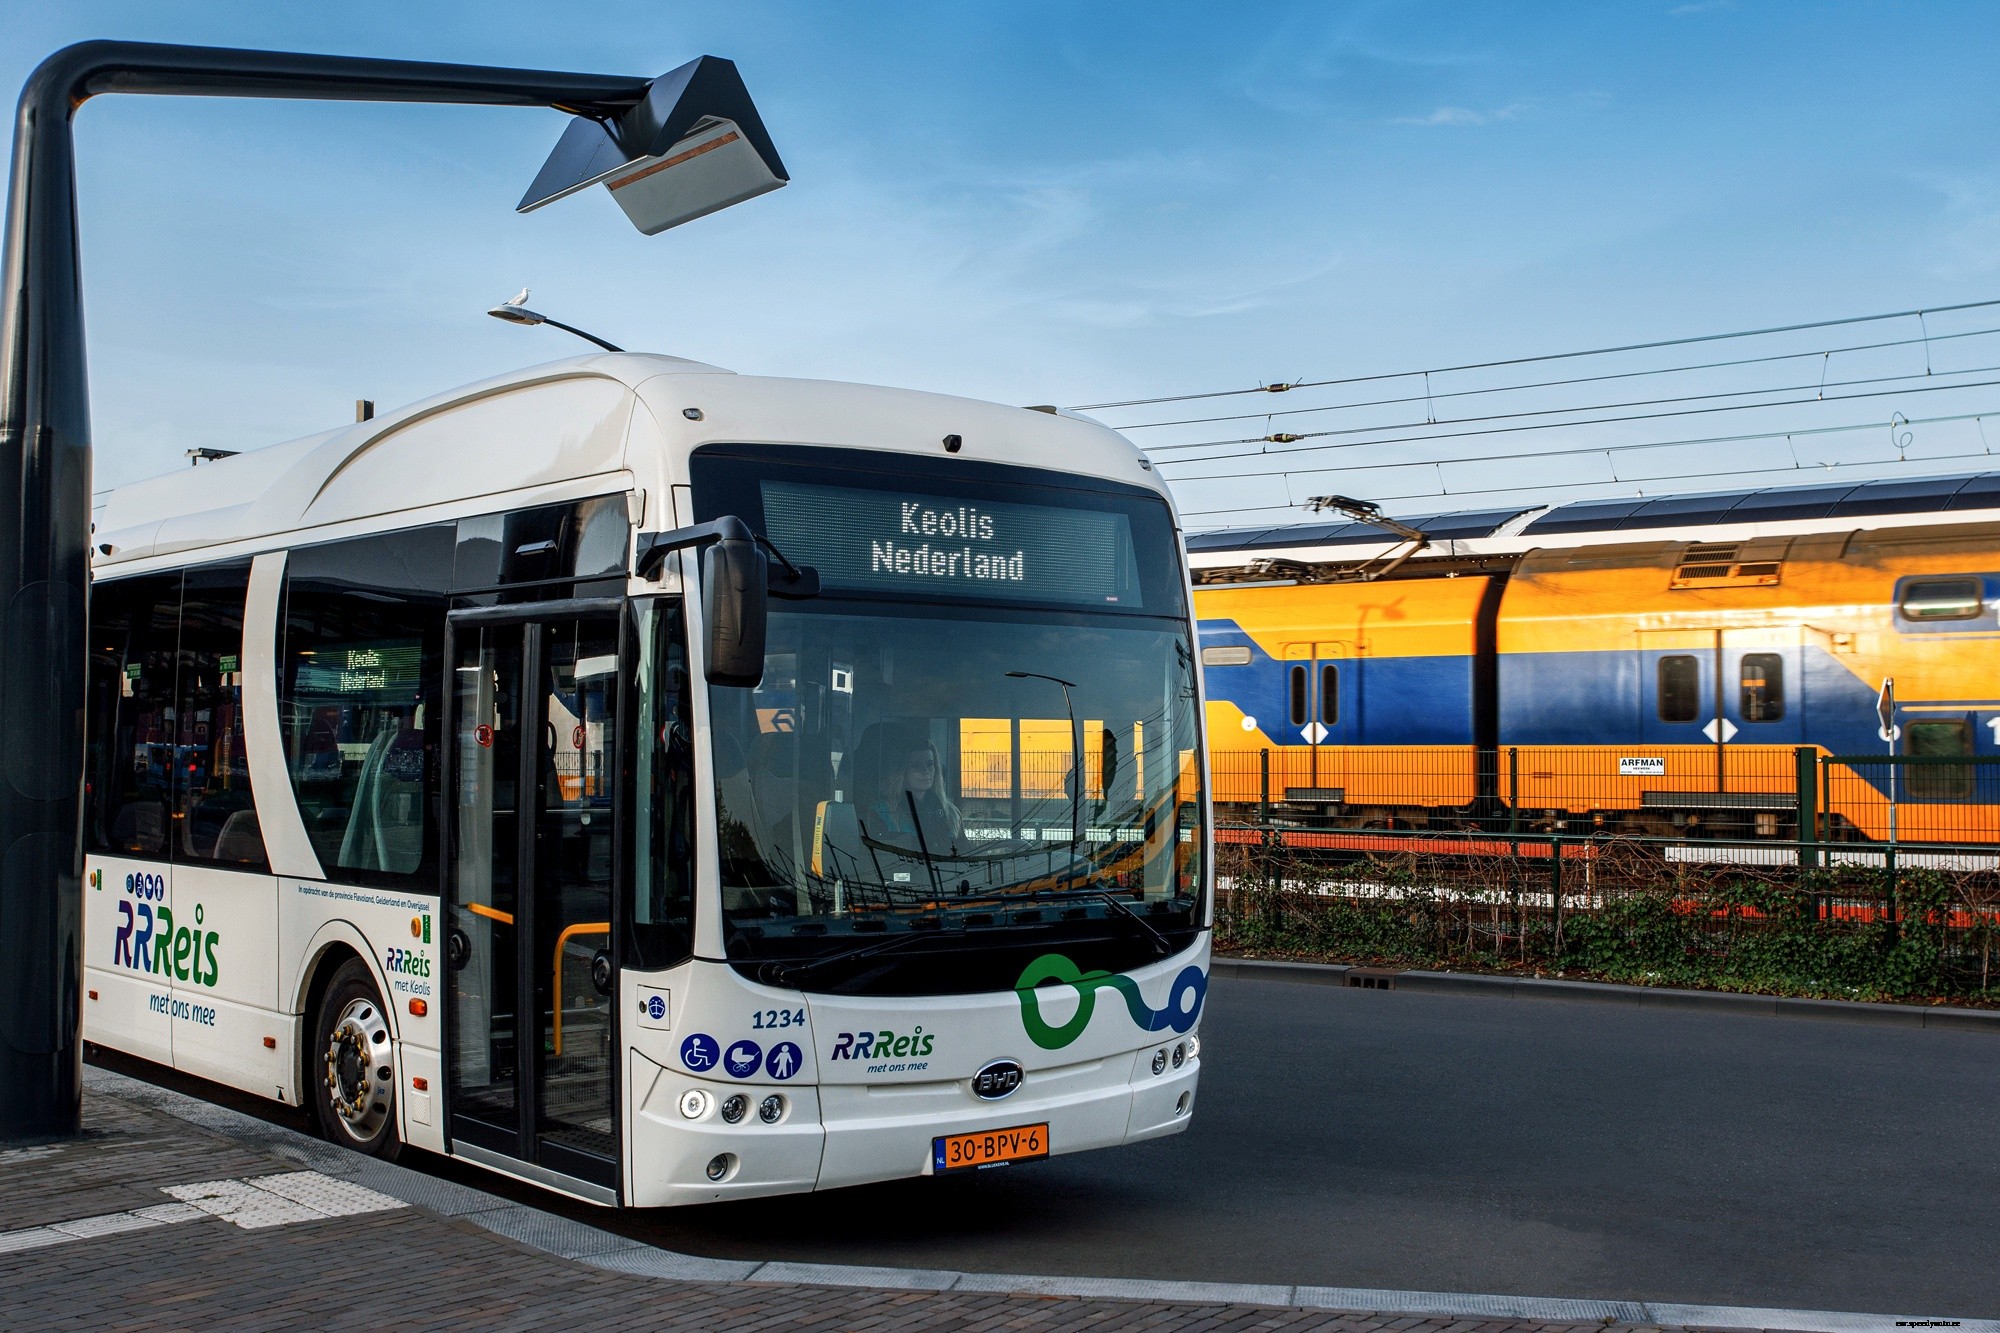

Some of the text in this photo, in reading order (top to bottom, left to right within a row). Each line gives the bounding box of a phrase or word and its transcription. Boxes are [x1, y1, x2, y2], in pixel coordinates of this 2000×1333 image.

[901, 502, 994, 539] Keolis
[872, 540, 1023, 581] Nederland
[114, 900, 220, 988] RRReis
[386, 947, 430, 977] RRReis
[394, 980, 430, 995] met Keolis
[150, 993, 216, 1027] met ons mee
[752, 1008, 806, 1030] 1234
[831, 1025, 935, 1061] RRReis
[867, 1062, 928, 1073] met ons mee
[978, 1070, 1019, 1091] BYD
[936, 1130, 1040, 1165] NL 30-BPV-6
